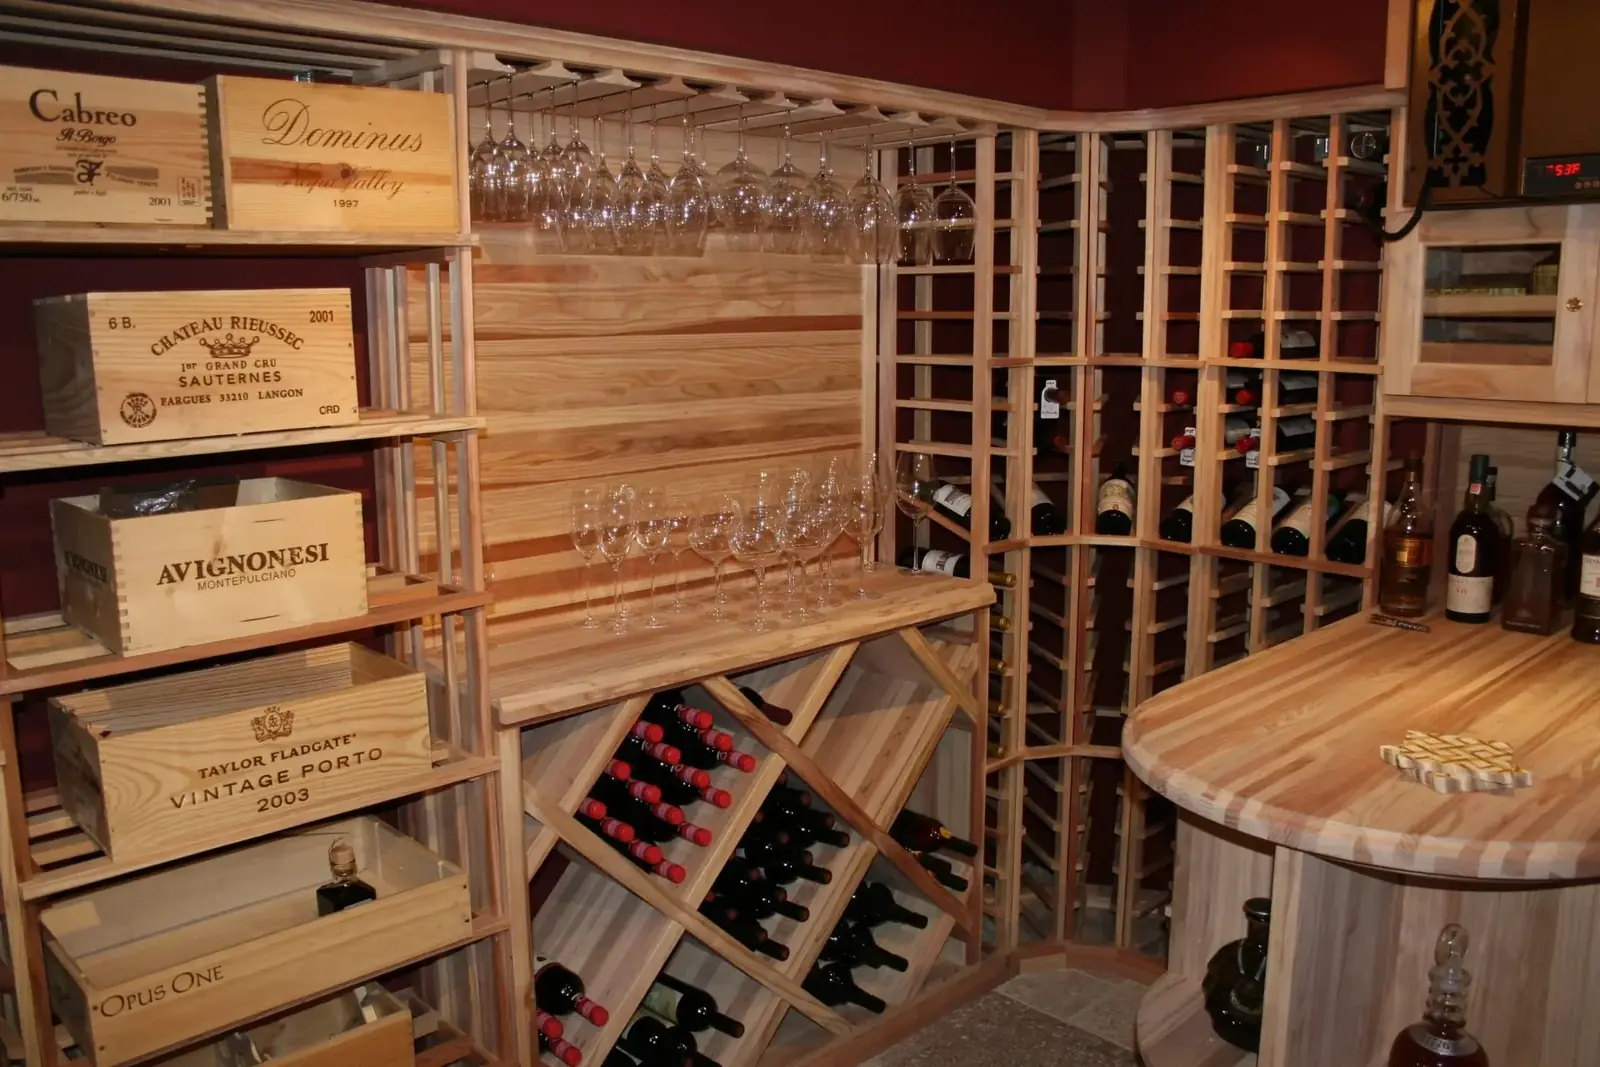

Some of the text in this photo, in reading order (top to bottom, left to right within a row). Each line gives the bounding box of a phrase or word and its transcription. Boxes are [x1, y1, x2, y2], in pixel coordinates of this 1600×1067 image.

[28, 88, 137, 127] Cabreo
[261, 98, 423, 152] Dominus
[149, 197, 171, 206] 2001
[333, 199, 359, 208] 1997
[108, 316, 136, 330] 6 B.
[309, 310, 334, 323] 2001
[151, 316, 304, 356] CHATEAU RIEUSSEC
[205, 360, 247, 371] GRAND
[254, 358, 277, 369] CRU
[178, 370, 282, 388] SAUTERNES
[160, 388, 304, 406] FARGUES 33210 LANGON
[319, 404, 340, 415] CRD
[156, 542, 330, 586] AVIGNONESI
[197, 568, 297, 591] MONTEPULCIANO
[198, 755, 266, 779] TAYLOR
[170, 747, 383, 809] VINTAGE PORTO
[257, 788, 309, 813] 2003
